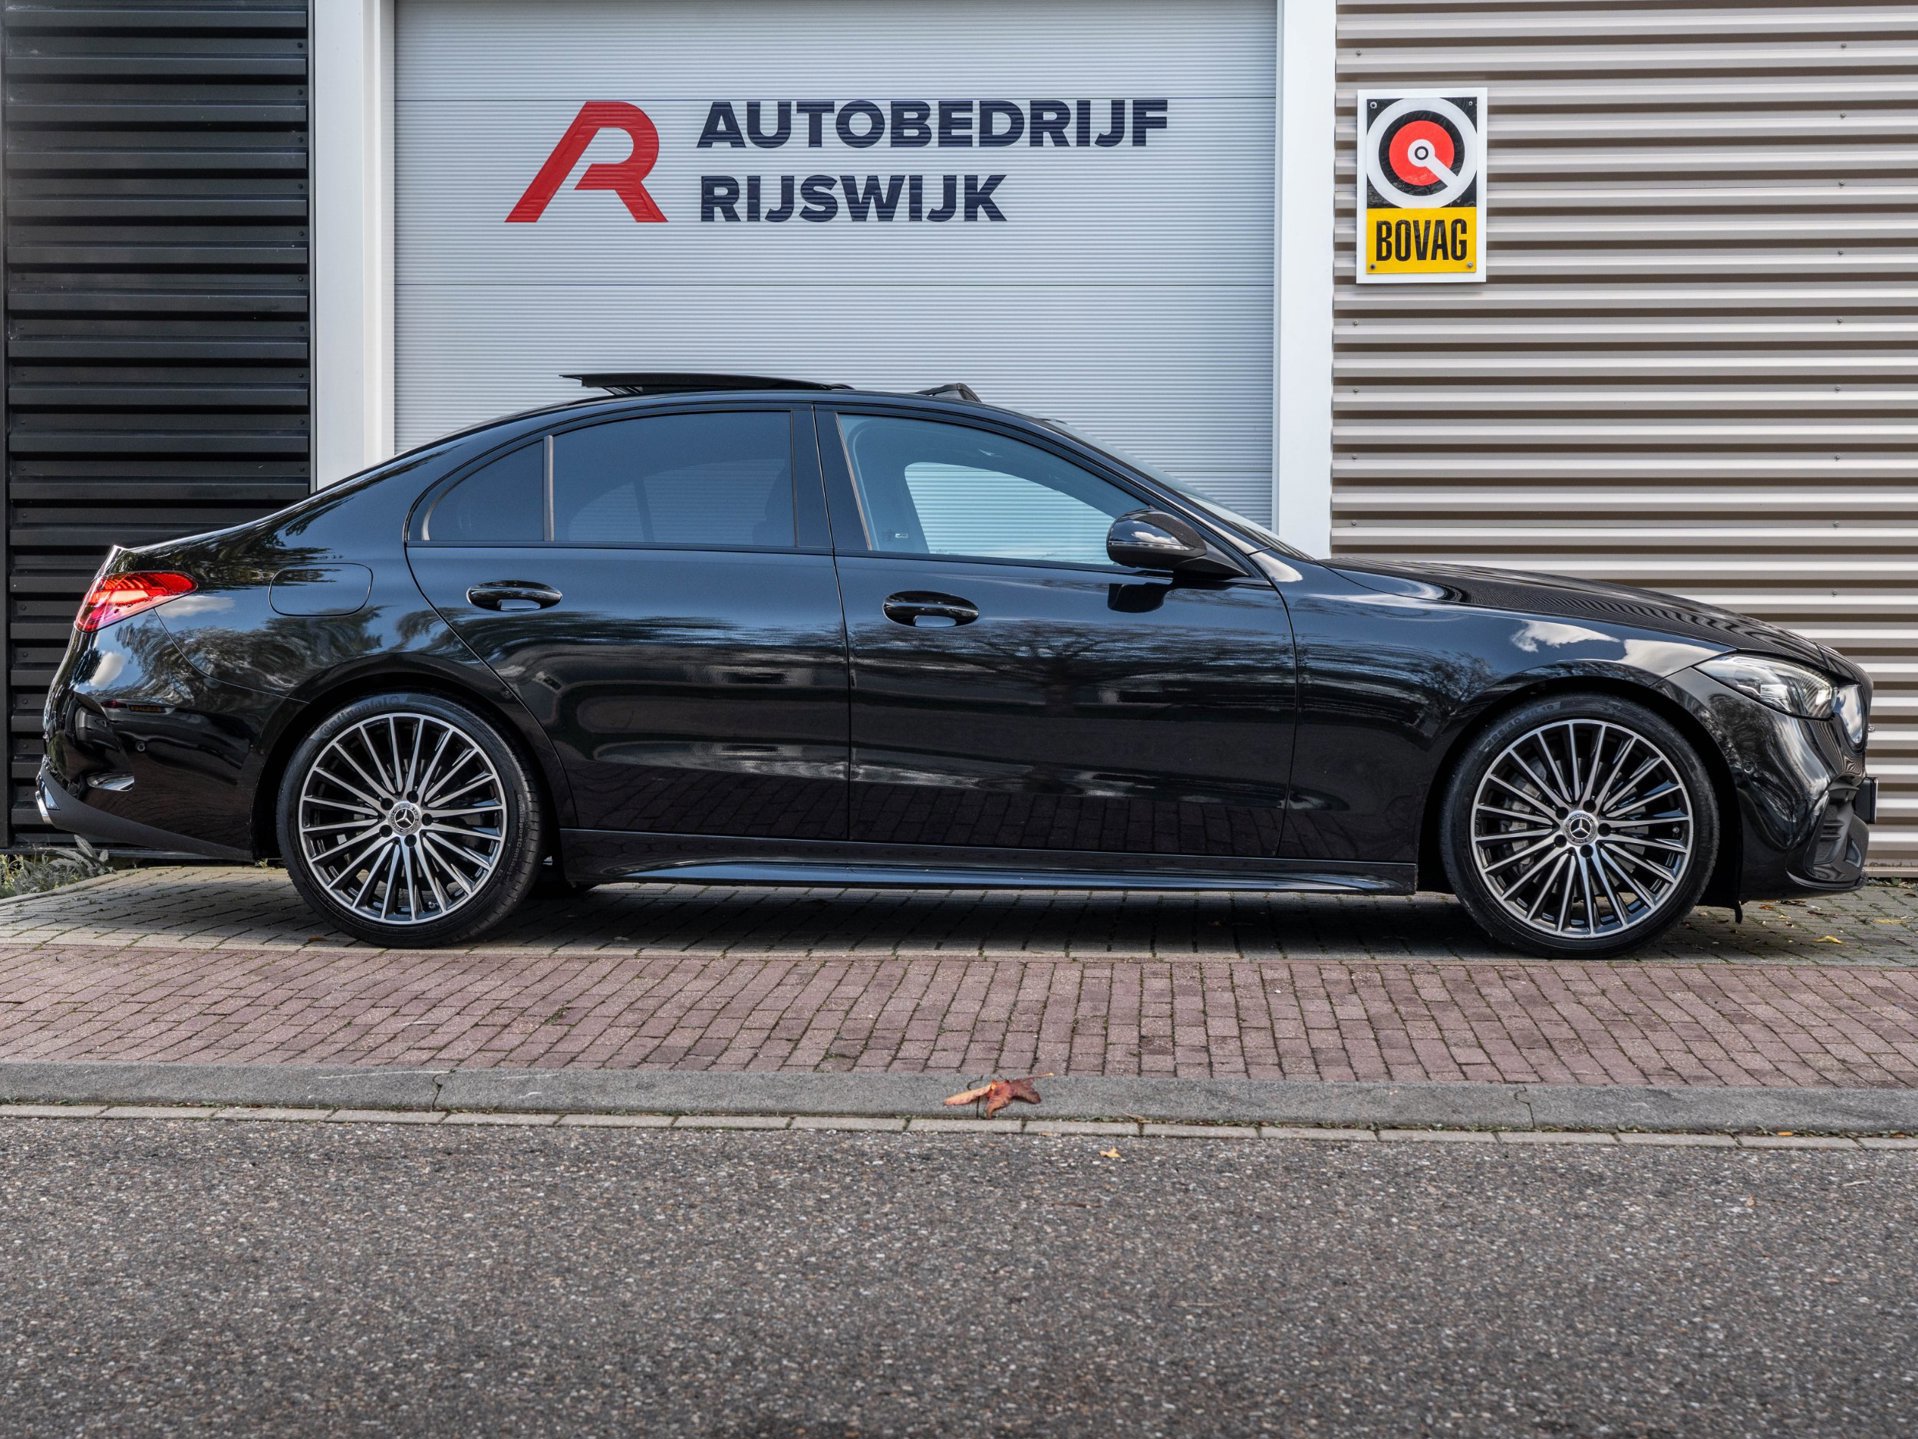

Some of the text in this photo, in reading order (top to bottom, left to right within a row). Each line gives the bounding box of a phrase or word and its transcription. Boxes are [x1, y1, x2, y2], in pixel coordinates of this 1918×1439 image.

[697, 99, 1169, 149] AUTOBEDRIJF
[700, 174, 1008, 222] RIJSWIJK
[1376, 218, 1468, 262] BOVAG
